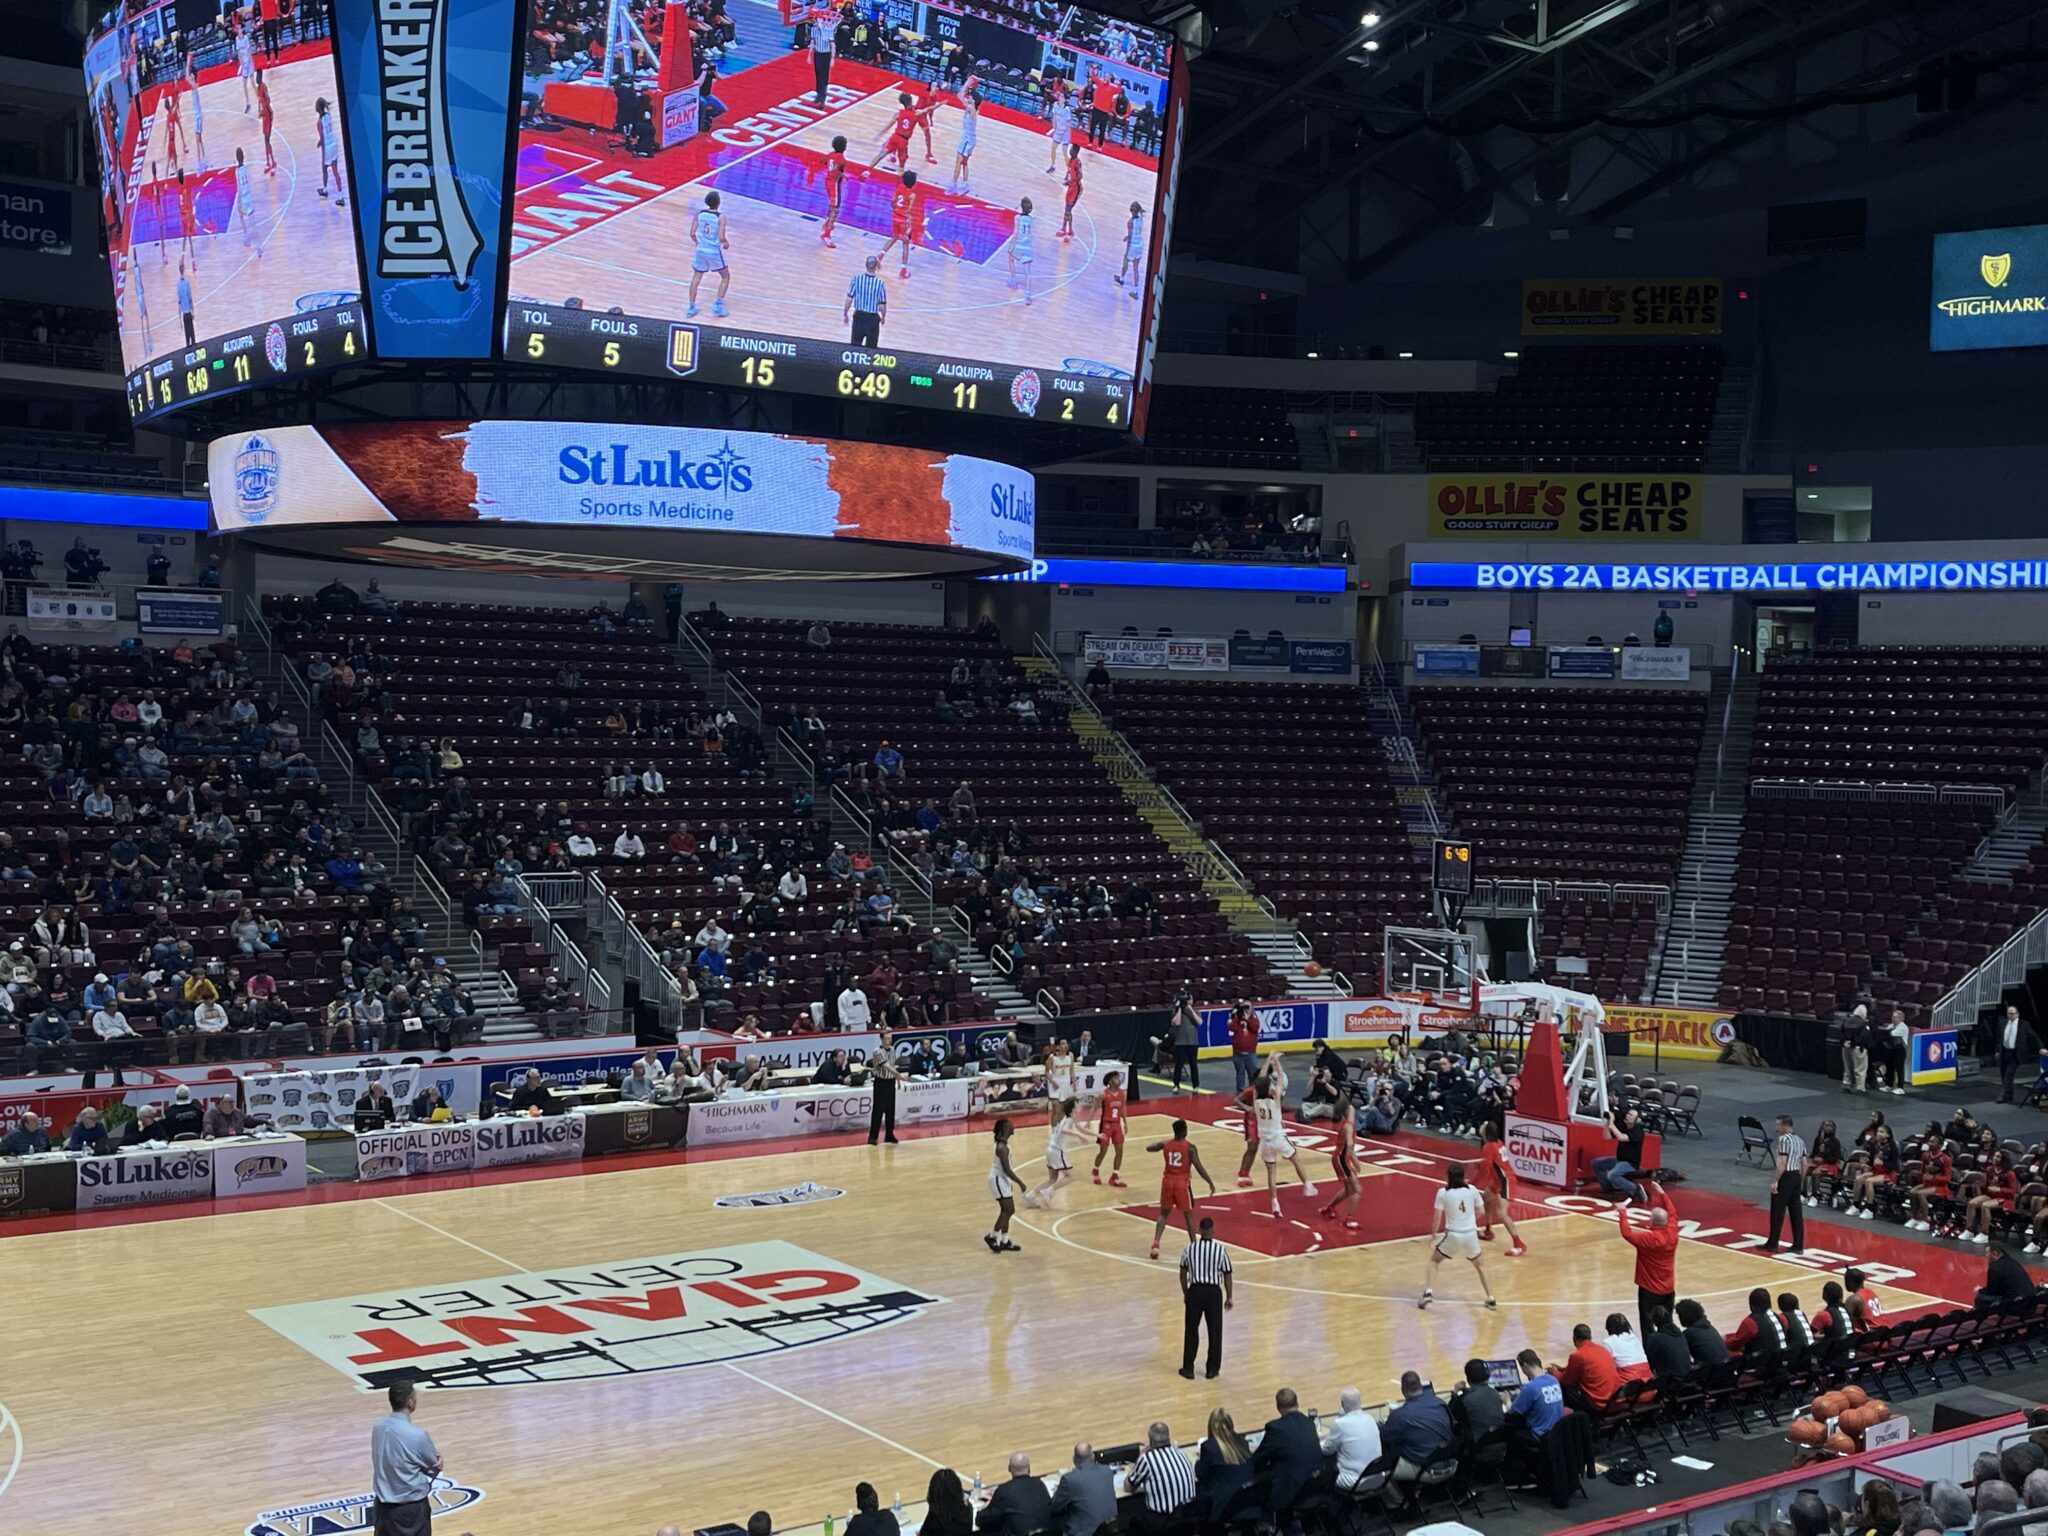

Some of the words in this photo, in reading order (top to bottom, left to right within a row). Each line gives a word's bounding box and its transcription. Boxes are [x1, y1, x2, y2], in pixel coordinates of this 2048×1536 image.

[938, 24, 957, 39] 101
[665, 106, 697, 129] GIANT
[1632, 285, 1720, 305] CHEAP
[1633, 305, 1717, 325] SEATS
[1940, 296, 2046, 317] HIGHMARK
[292, 318, 319, 336] FOULS
[336, 311, 355, 326] TOL
[523, 310, 552, 326] TOL
[591, 318, 639, 336] FOULS
[304, 341, 316, 366] 2
[343, 331, 355, 356] 4
[527, 332, 545, 359] 5
[720, 335, 797, 357] MENNONITE
[603, 341, 620, 367] 5
[842, 351, 871, 366] QTR:
[873, 354, 897, 368] 2ND
[233, 353, 251, 383] 11
[740, 356, 775, 387] 15
[937, 362, 994, 381] ALIQUIPPA
[160, 377, 172, 404] 15
[186, 366, 209, 395] 6:49
[838, 369, 892, 399] 6:49
[1053, 377, 1085, 393] FOULS
[953, 382, 977, 410] 11
[1106, 384, 1124, 398] TOL
[1061, 398, 1074, 420] 2
[1106, 403, 1118, 424] 4
[1576, 481, 1692, 507] CHEAP
[580, 497, 643, 519] Sports
[649, 500, 734, 521] Medicine
[1578, 507, 1689, 533] SEATS
[1477, 565, 1554, 588] BOYS
[1563, 565, 1602, 588] 2A
[1611, 565, 1806, 589] BASKETBALL
[1086, 640, 1118, 651] STREAM
[1119, 641, 1131, 652] ON
[1132, 641, 1166, 653] DEMAND
[1169, 644, 1204, 656] BEEF
[1634, 1019, 1710, 1047] SHACK
[627, 1115, 648, 1124] ARMY
[701, 1102, 768, 1119] HIGHMARK
[1111, 1107, 1119, 1119] 2
[1259, 1107, 1273, 1120] 21
[705, 1124, 744, 1135] Because
[359, 1136, 427, 1156] OFFICIAL
[431, 1128, 471, 1146] DVDS
[443, 1147, 469, 1163] PCN
[1168, 1151, 1183, 1168] 12
[1508, 1140, 1564, 1165] GIANT
[1514, 1158, 1557, 1177] CENTER
[94, 1193, 136, 1206] Sports
[139, 1188, 197, 1201] Medicine
[1458, 1200, 1466, 1214] 4
[355, 1257, 744, 1322] CENTER
[348, 1269, 862, 1366] GIANT
[1875, 1429, 1900, 1446] SPALDING
